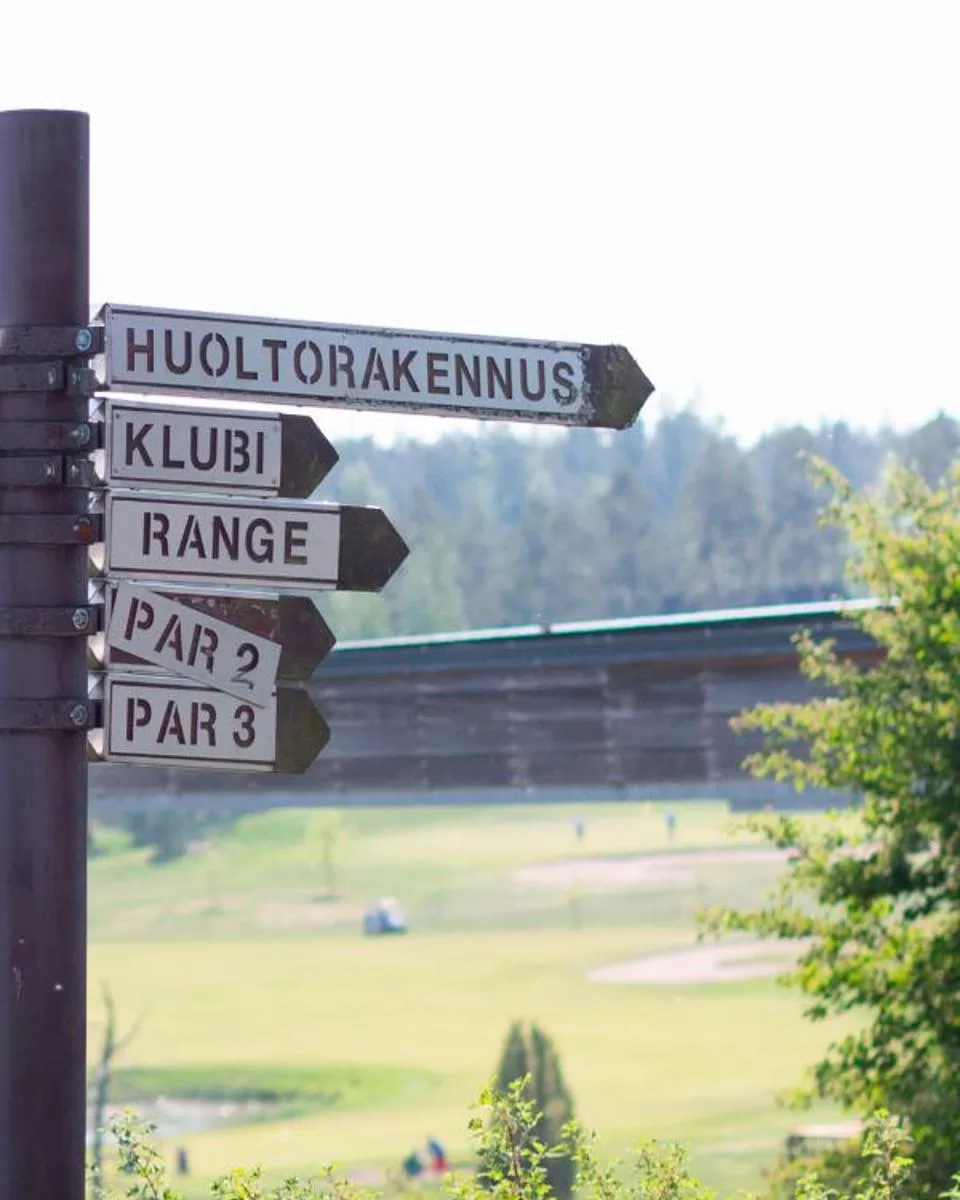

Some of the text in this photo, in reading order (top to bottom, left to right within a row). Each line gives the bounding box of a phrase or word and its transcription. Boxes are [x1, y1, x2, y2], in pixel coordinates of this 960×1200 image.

[126, 328, 576, 405] HUOLTORAKENNUS
[125, 422, 264, 474] KLUBI
[142, 512, 308, 565] RANGE
[124, 597, 259, 690] PAR 2
[126, 698, 255, 748] PAR 3
